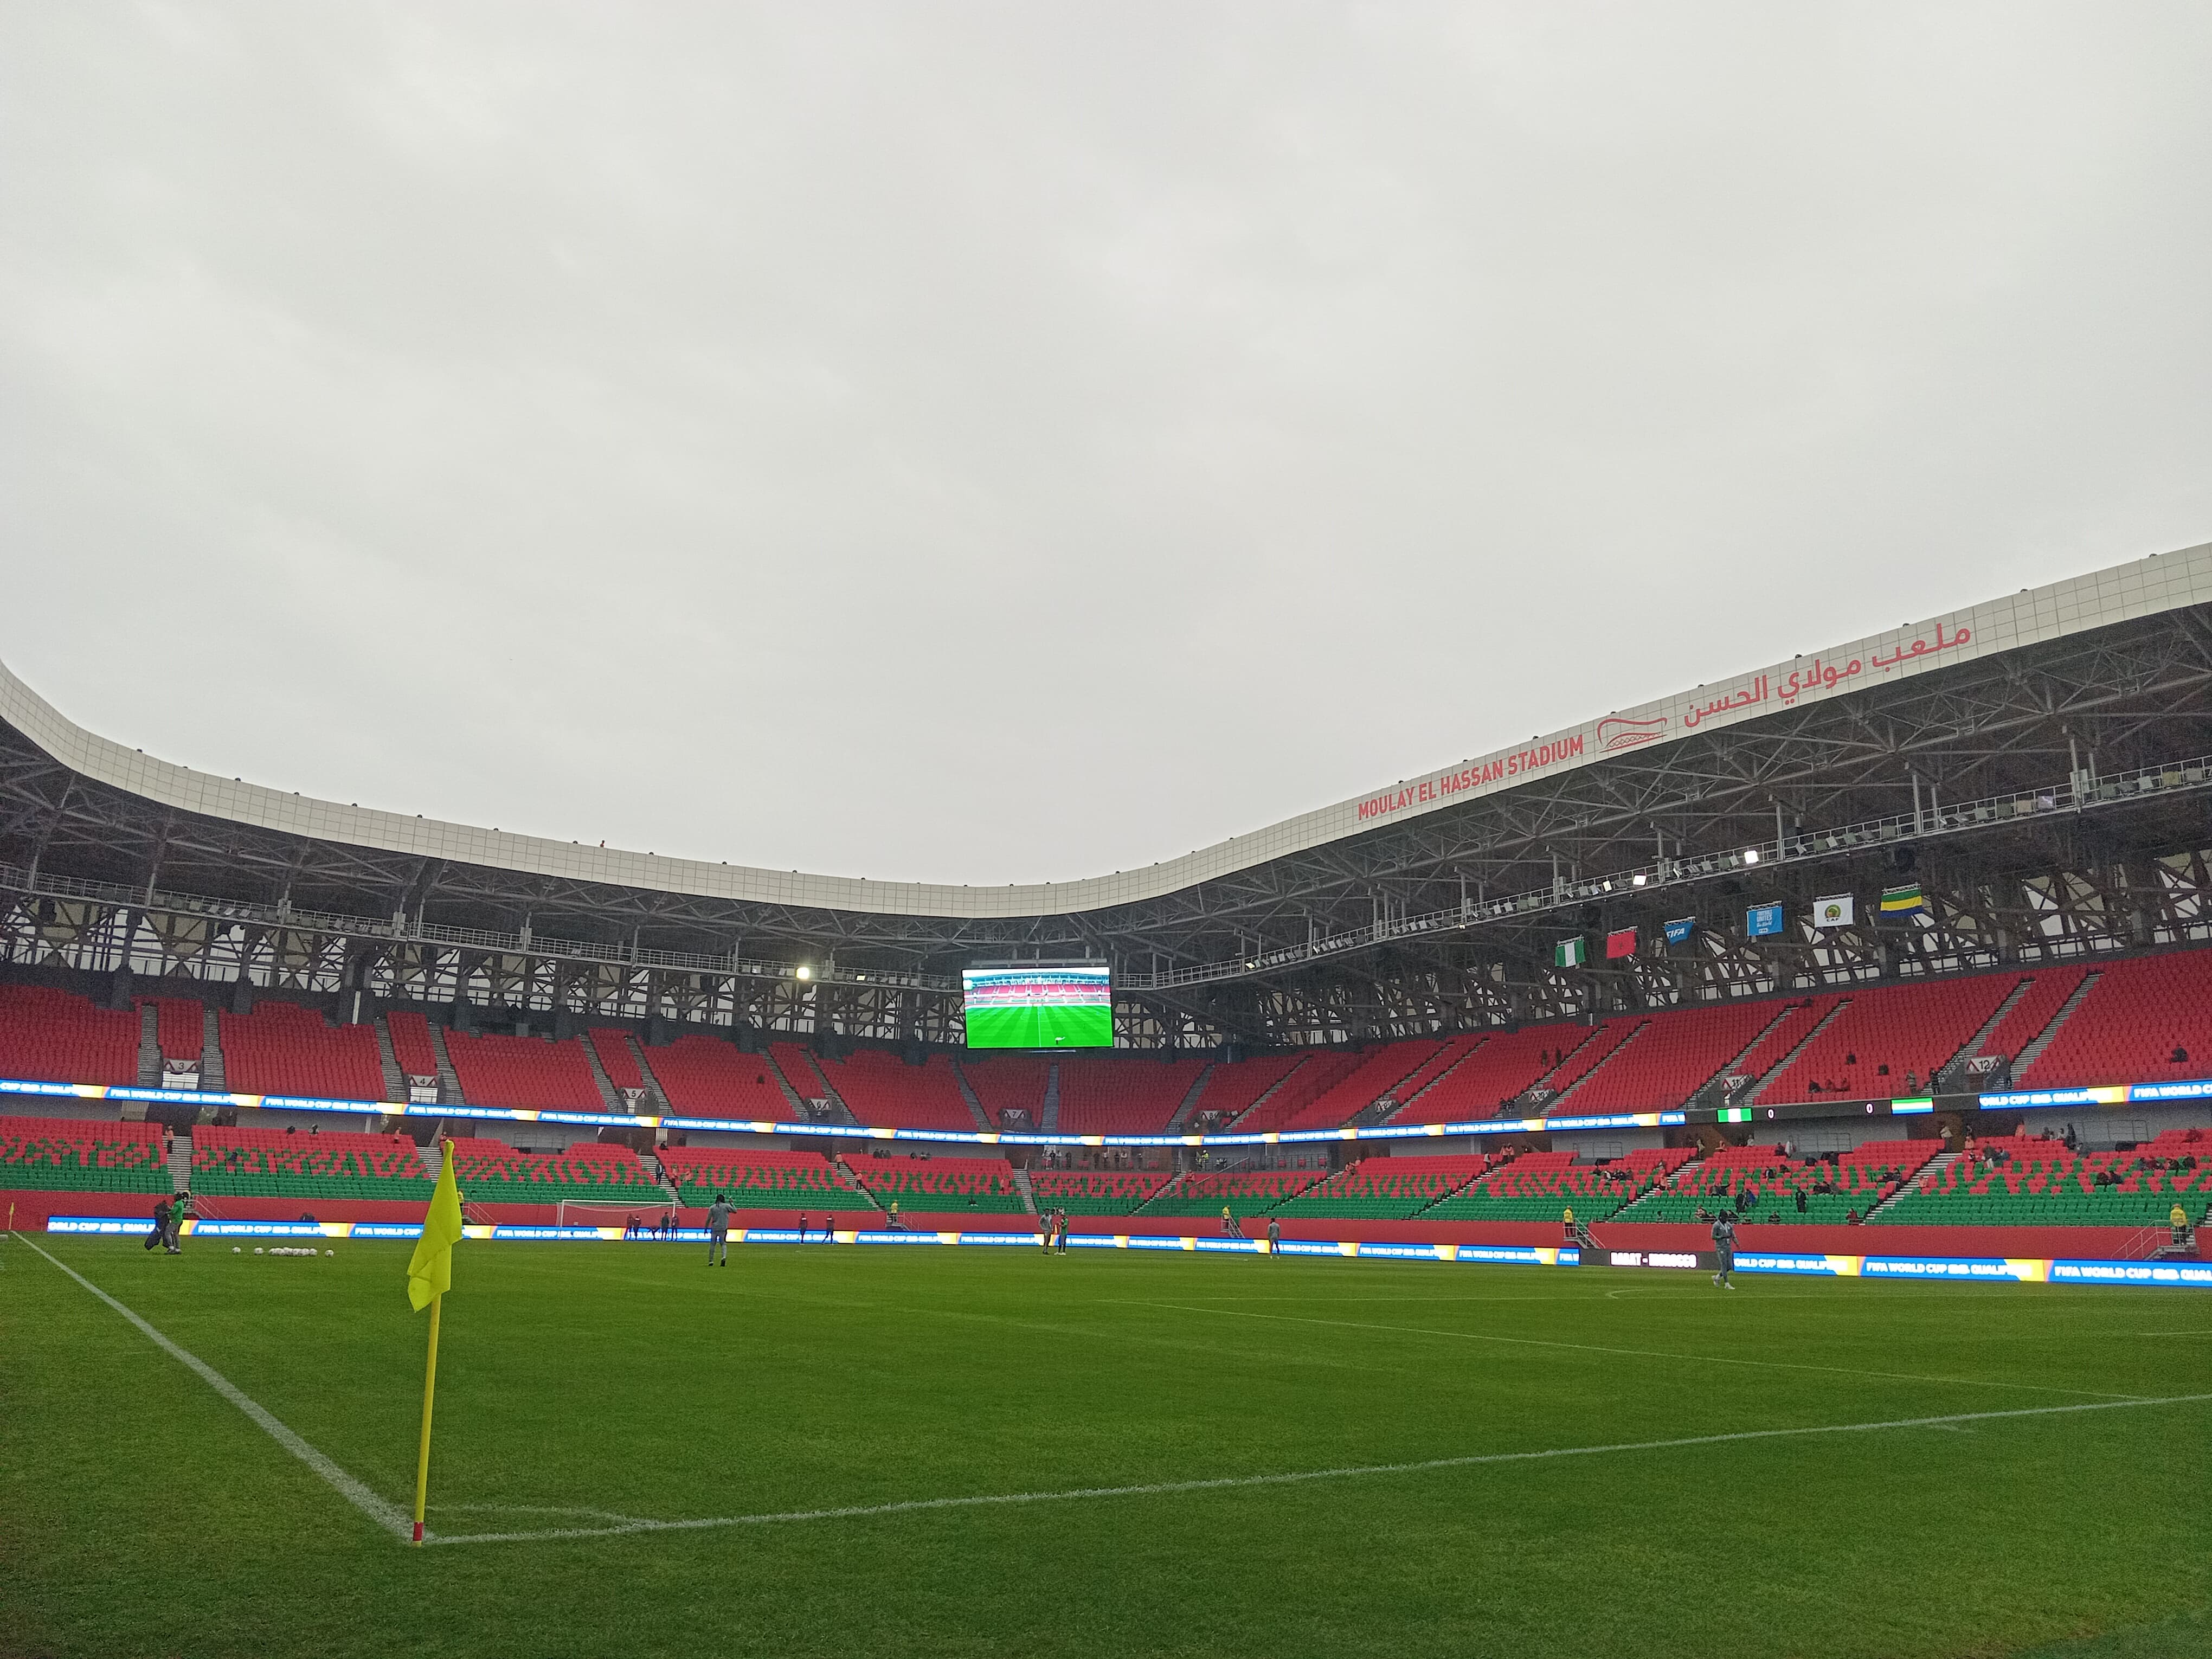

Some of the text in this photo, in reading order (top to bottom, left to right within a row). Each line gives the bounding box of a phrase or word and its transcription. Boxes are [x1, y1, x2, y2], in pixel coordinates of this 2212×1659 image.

[1685, 623, 1970, 727] ملعب مولاي الحسن
[1359, 735, 1584, 819] MOULAY EL HASSAN STADIUM
[1667, 928, 1685, 938] FIFA
[1979, 1060, 1990, 1069] 12
[2134, 1088, 2159, 1097] FIFA
[2159, 1085, 2202, 1096] WORLD
[1767, 1103, 1873, 1118] 0 0
[1867, 1263, 1888, 1271] FIFA
[1888, 1263, 1925, 1272] WORLD
[1926, 1264, 1947, 1273] CUP
[2055, 1266, 2080, 1276] FIFA
[2081, 1267, 2125, 1278] WORLD
[2126, 1268, 2152, 1278] CUP
